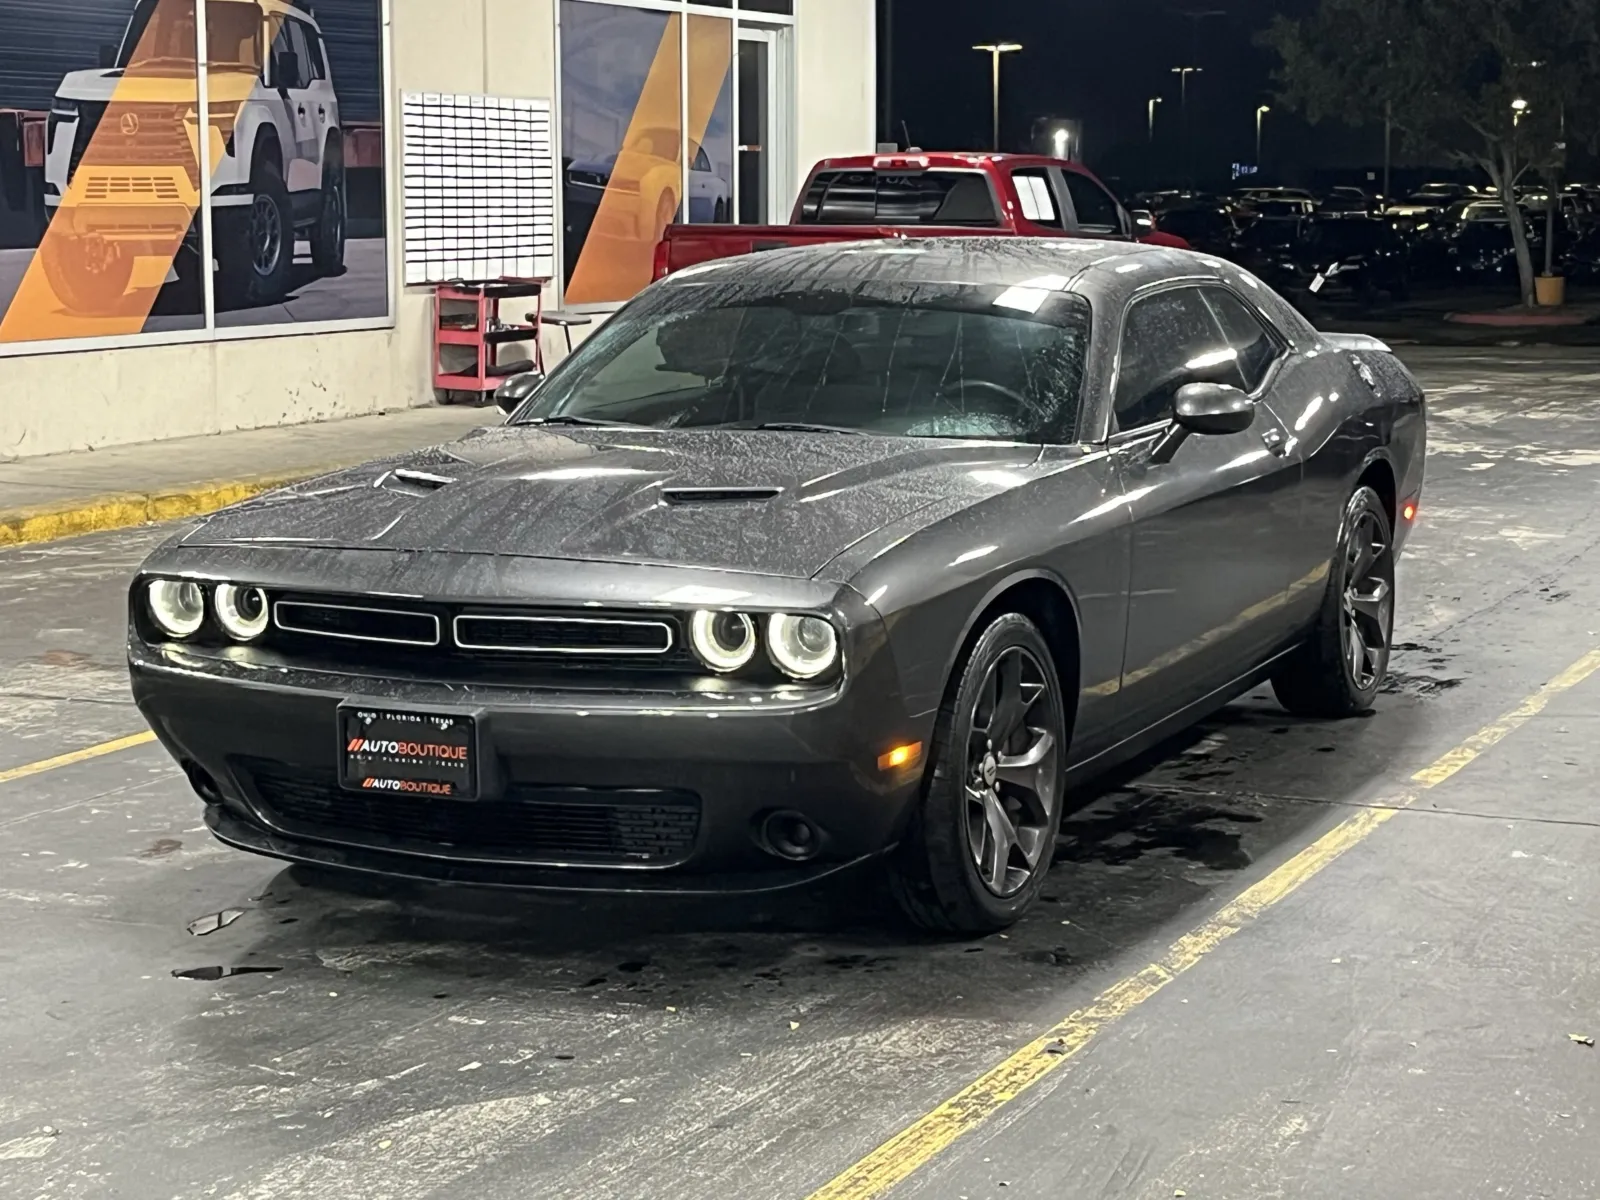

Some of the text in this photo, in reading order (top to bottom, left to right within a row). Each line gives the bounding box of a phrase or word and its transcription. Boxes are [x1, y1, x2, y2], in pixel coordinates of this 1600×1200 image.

[357, 711, 454, 725] OHIO FLORIDA TEXAS
